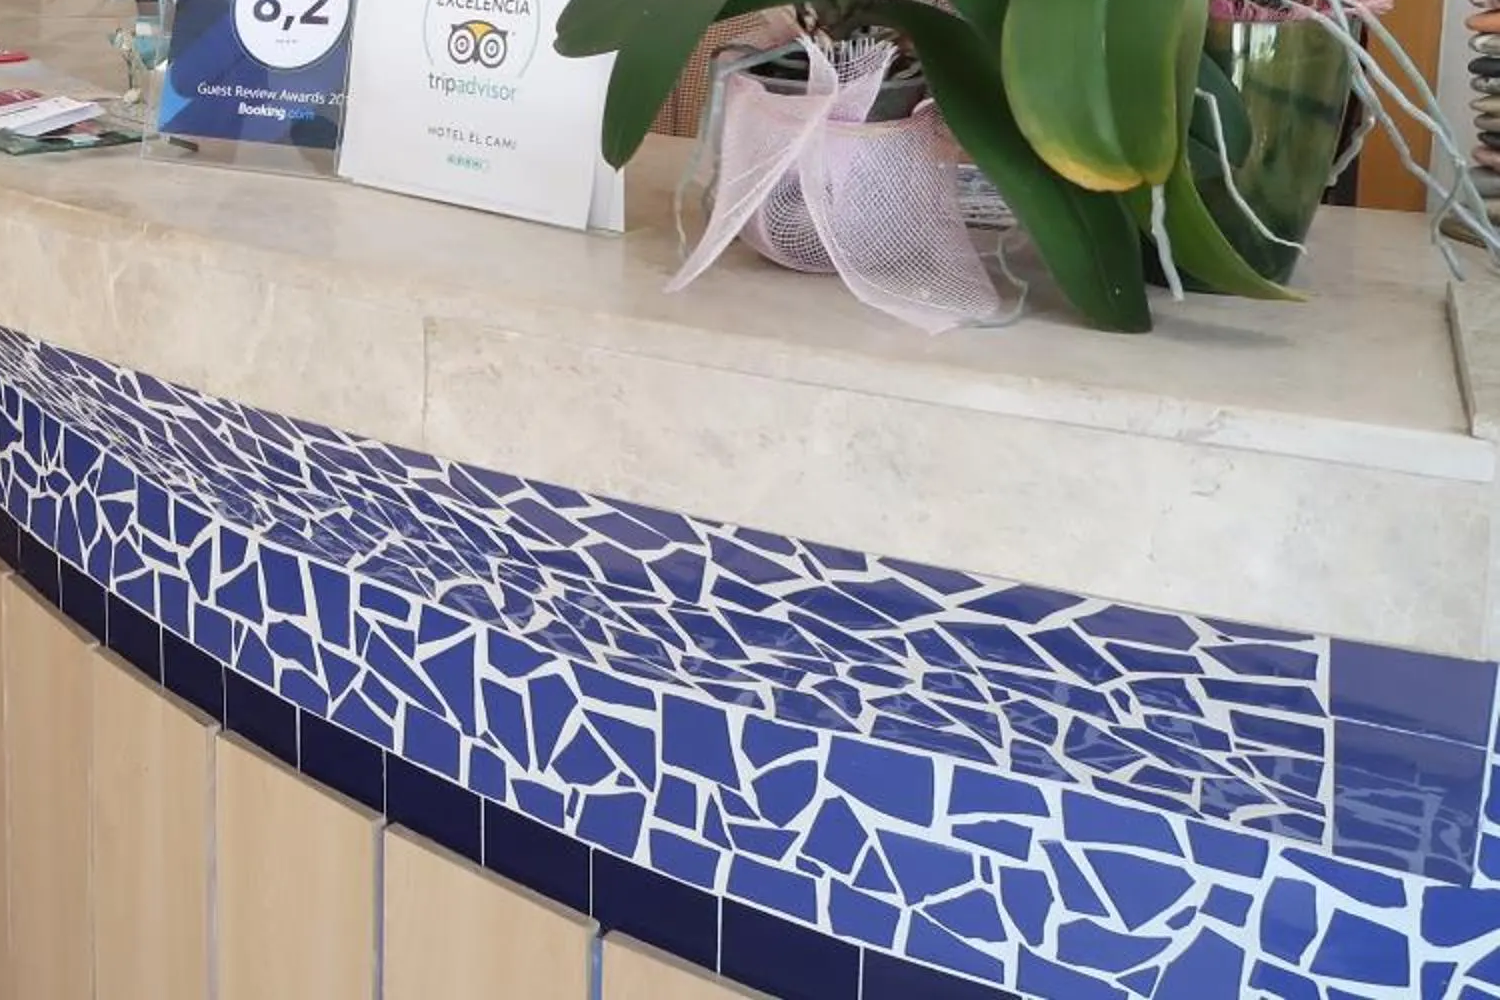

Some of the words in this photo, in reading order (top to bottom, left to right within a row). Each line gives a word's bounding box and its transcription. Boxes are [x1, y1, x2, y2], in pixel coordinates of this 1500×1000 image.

[197, 81, 232, 97] Guest
[235, 85, 277, 101] Review
[279, 89, 325, 105] Awards
[428, 72, 518, 101] tripadvisor
[237, 101, 316, 122] Booking.com
[428, 126, 464, 142] HOTEL
